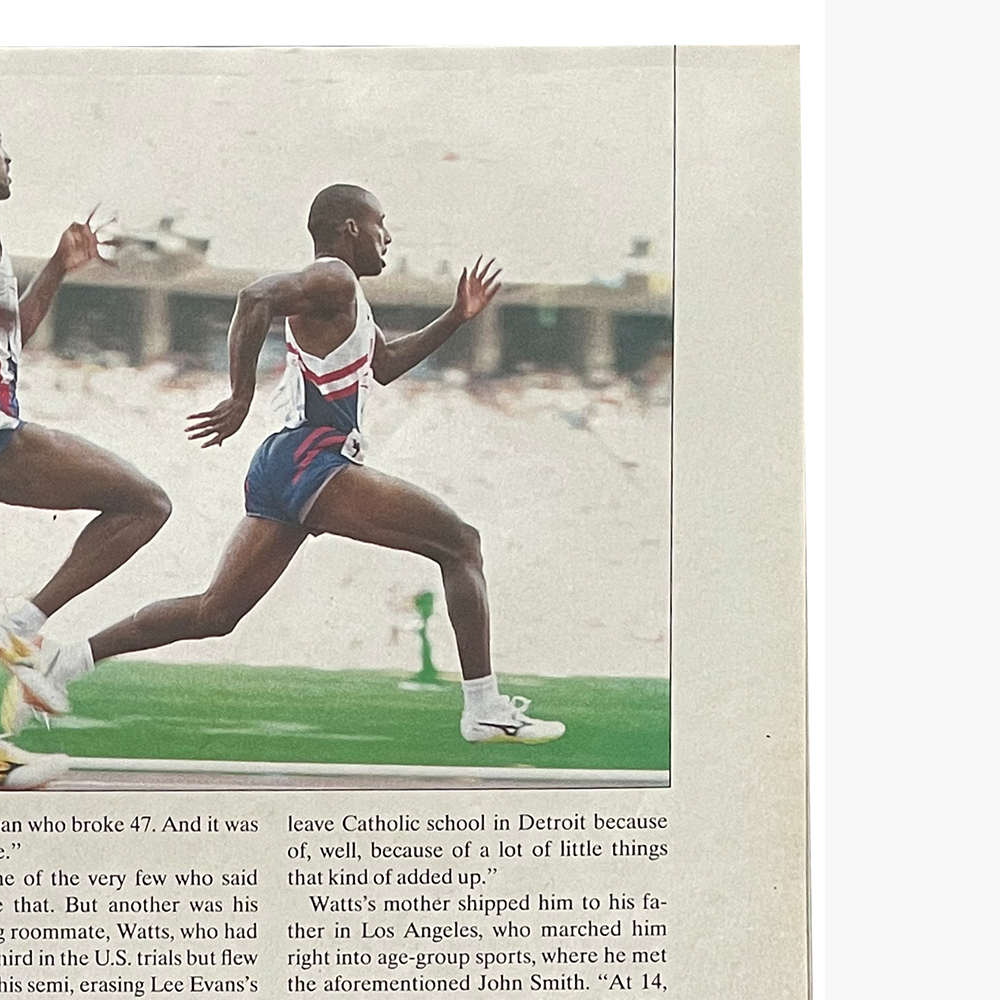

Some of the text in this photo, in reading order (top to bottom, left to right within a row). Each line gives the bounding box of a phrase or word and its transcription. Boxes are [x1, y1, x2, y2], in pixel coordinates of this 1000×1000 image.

[289, 813, 667, 832] leave Catholic school in Detroit because
[11, 926, 110, 942] roommate,
[117, 923, 174, 942] Watts,
[180, 923, 218, 939] who
[225, 923, 257, 939] had
[288, 947, 666, 970] right into age-group sports, where he met
